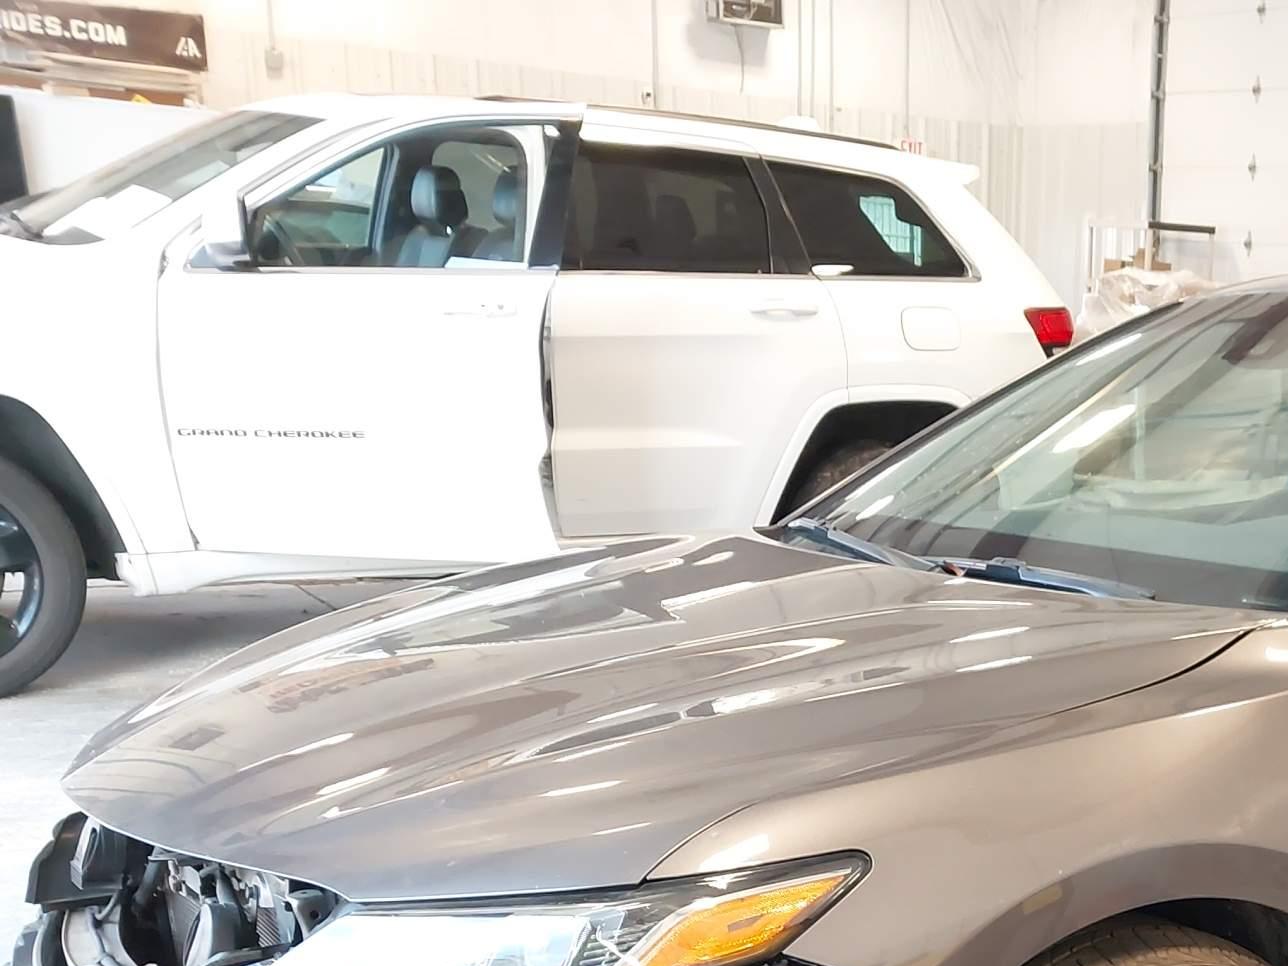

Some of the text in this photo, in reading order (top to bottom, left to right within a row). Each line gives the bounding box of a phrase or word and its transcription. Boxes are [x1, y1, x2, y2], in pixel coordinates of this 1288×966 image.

[0, 9, 127, 46] IDES.COM
[177, 428, 366, 439] GRAND CHEROKEE
